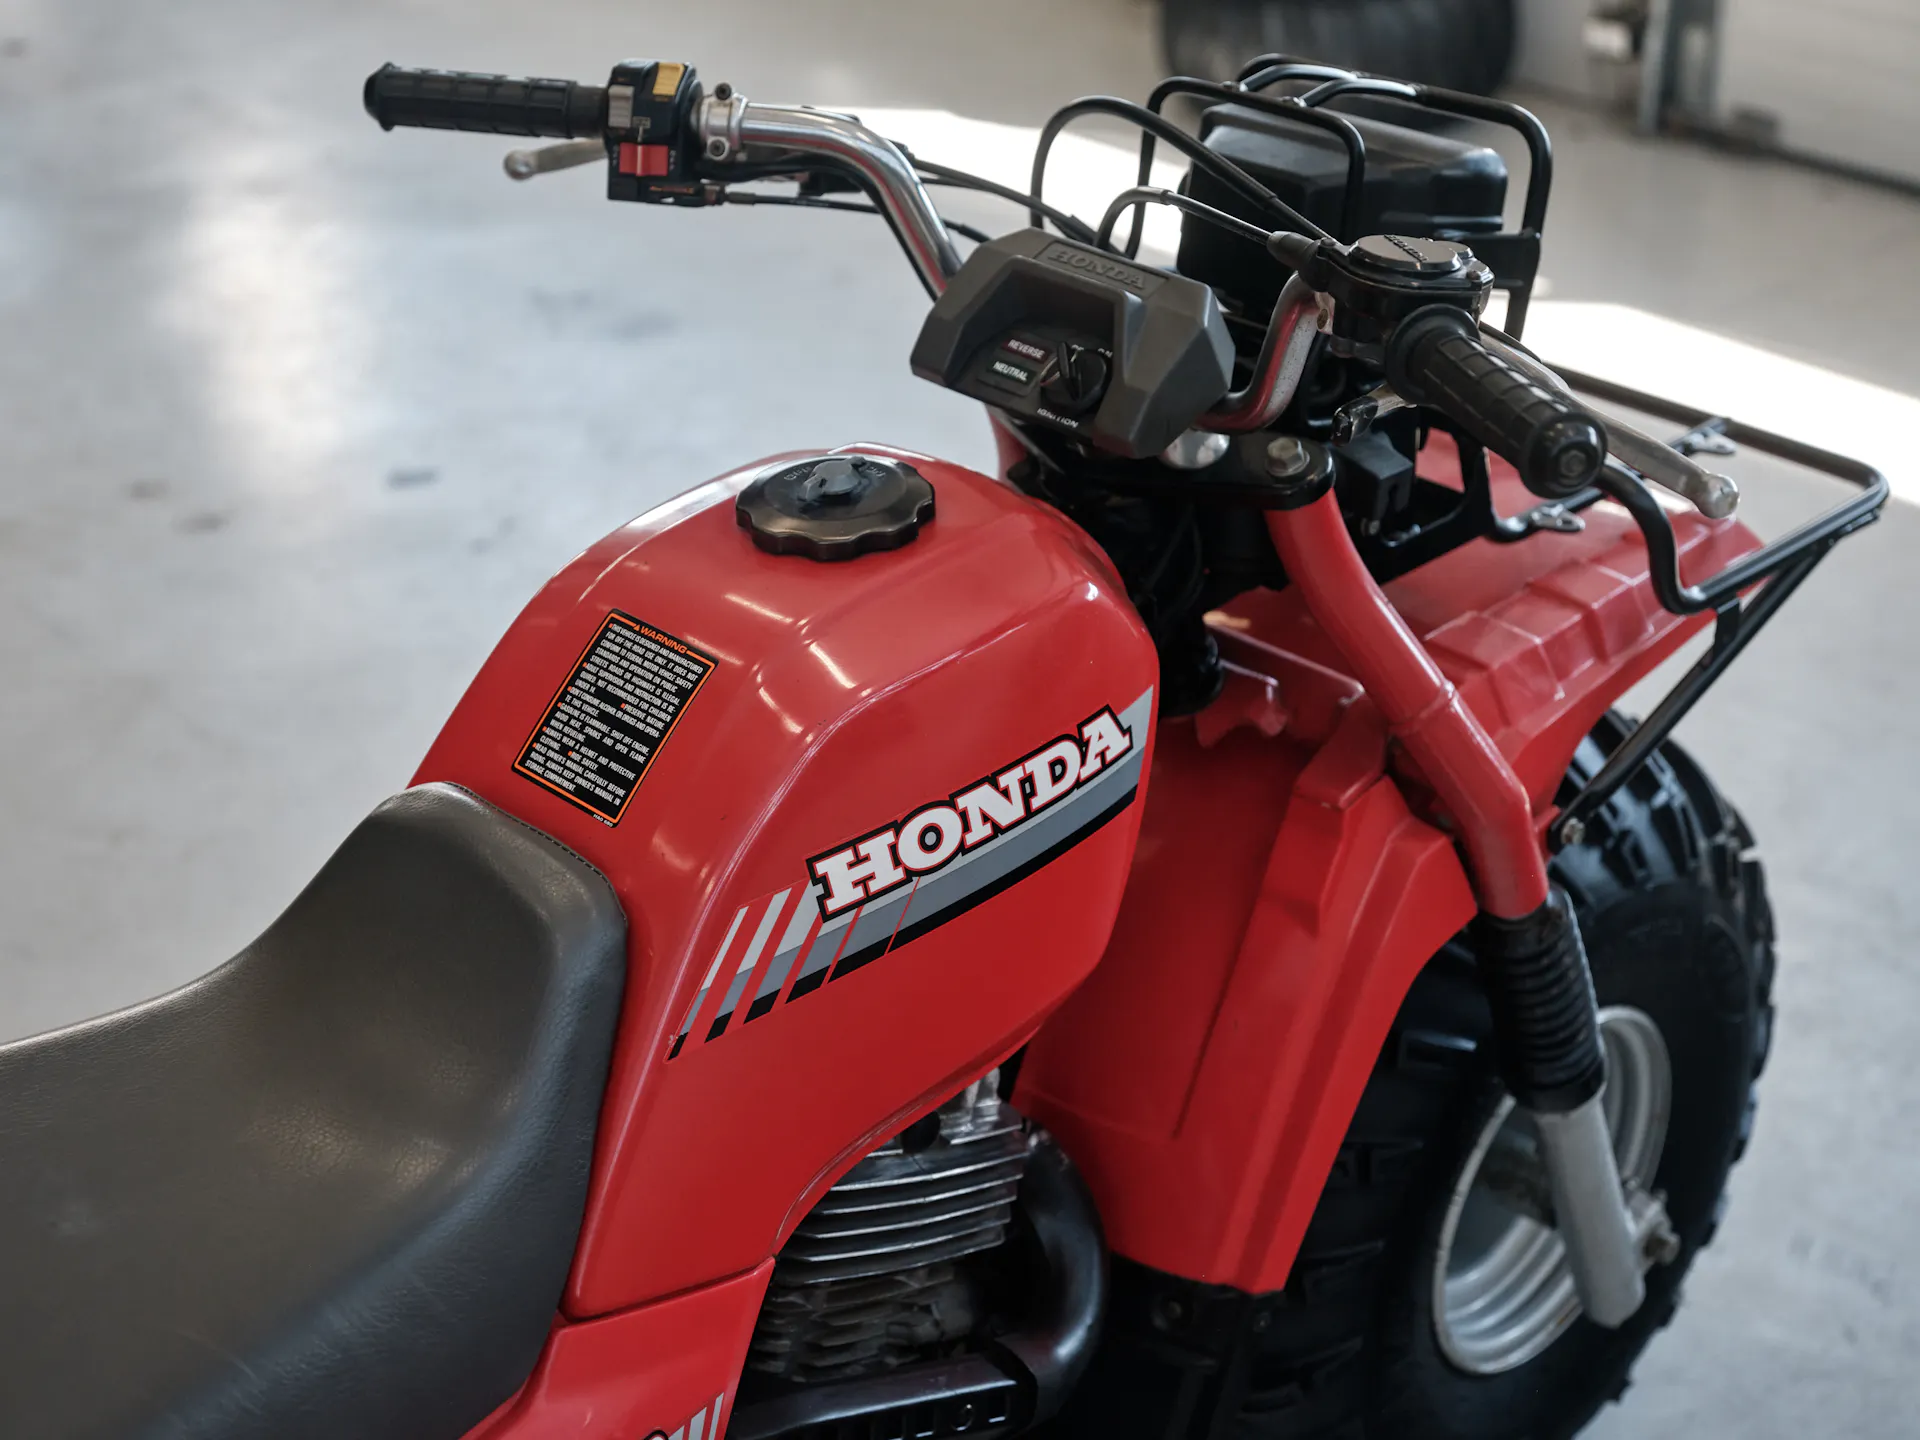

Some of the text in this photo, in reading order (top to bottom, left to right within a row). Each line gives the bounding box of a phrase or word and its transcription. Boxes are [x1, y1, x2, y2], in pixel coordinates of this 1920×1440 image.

[1049, 243, 1145, 290] HONDA
[1008, 340, 1045, 360] REVERSE
[993, 361, 1029, 382] NEUTRAL
[620, 628, 636, 640] VEHICLE
[639, 638, 660, 652] DESIGNED
[668, 652, 703, 674] MANUFACTURED
[641, 626, 687, 653] WARNING
[590, 655, 608, 668] STREETS
[609, 664, 624, 676] ROADS
[632, 676, 655, 692] HIGHWAYS
[595, 647, 620, 663] STANDARDS
[629, 664, 653, 680] OPERATION
[601, 640, 621, 652] CONFORM
[626, 652, 643, 665] FEDERAL
[643, 660, 659, 672] MOTOR
[659, 668, 676, 681] VEHICLE
[675, 677, 693, 689] SAFETY
[673, 666, 687, 676] DOES
[575, 679, 590, 690] UNDER
[585, 663, 599, 673] ADULT
[598, 670, 624, 686] SUPERVISION
[634, 688, 662, 706] INSTRUCTION
[572, 698, 582, 707] THIS
[581, 693, 600, 706] CONSUME
[599, 702, 616, 715] ALCOHOL
[622, 714, 637, 725] DRUGS
[607, 684, 639, 705] RECOMMENDED
[649, 706, 671, 722] CHILDREN
[623, 704, 646, 720] PRESERVE
[550, 719, 563, 730] WHEN
[555, 712, 569, 722] AVOID
[584, 726, 602, 739] SPARKS
[615, 743, 628, 754] OPEN
[629, 751, 646, 763] FLAME
[560, 703, 580, 717] GASOLINE
[611, 730, 624, 740] SHUT
[525, 760, 545, 774] STORAGE
[535, 743, 547, 754] READ
[566, 760, 584, 774] MANUAL
[584, 770, 608, 787] CAREFULLY
[607, 783, 626, 797] BEFORE
[545, 728, 562, 740] ALWAYS
[562, 736, 575, 747] WEAR
[580, 746, 598, 759] HELMET
[608, 762, 635, 780] PROTECTIVE
[570, 752, 582, 761] RIDE
[546, 761, 563, 773] ALWAYS
[563, 770, 575, 779] KEEP
[594, 787, 614, 802] MANUAL
[807, 705, 1133, 920] HONDA
